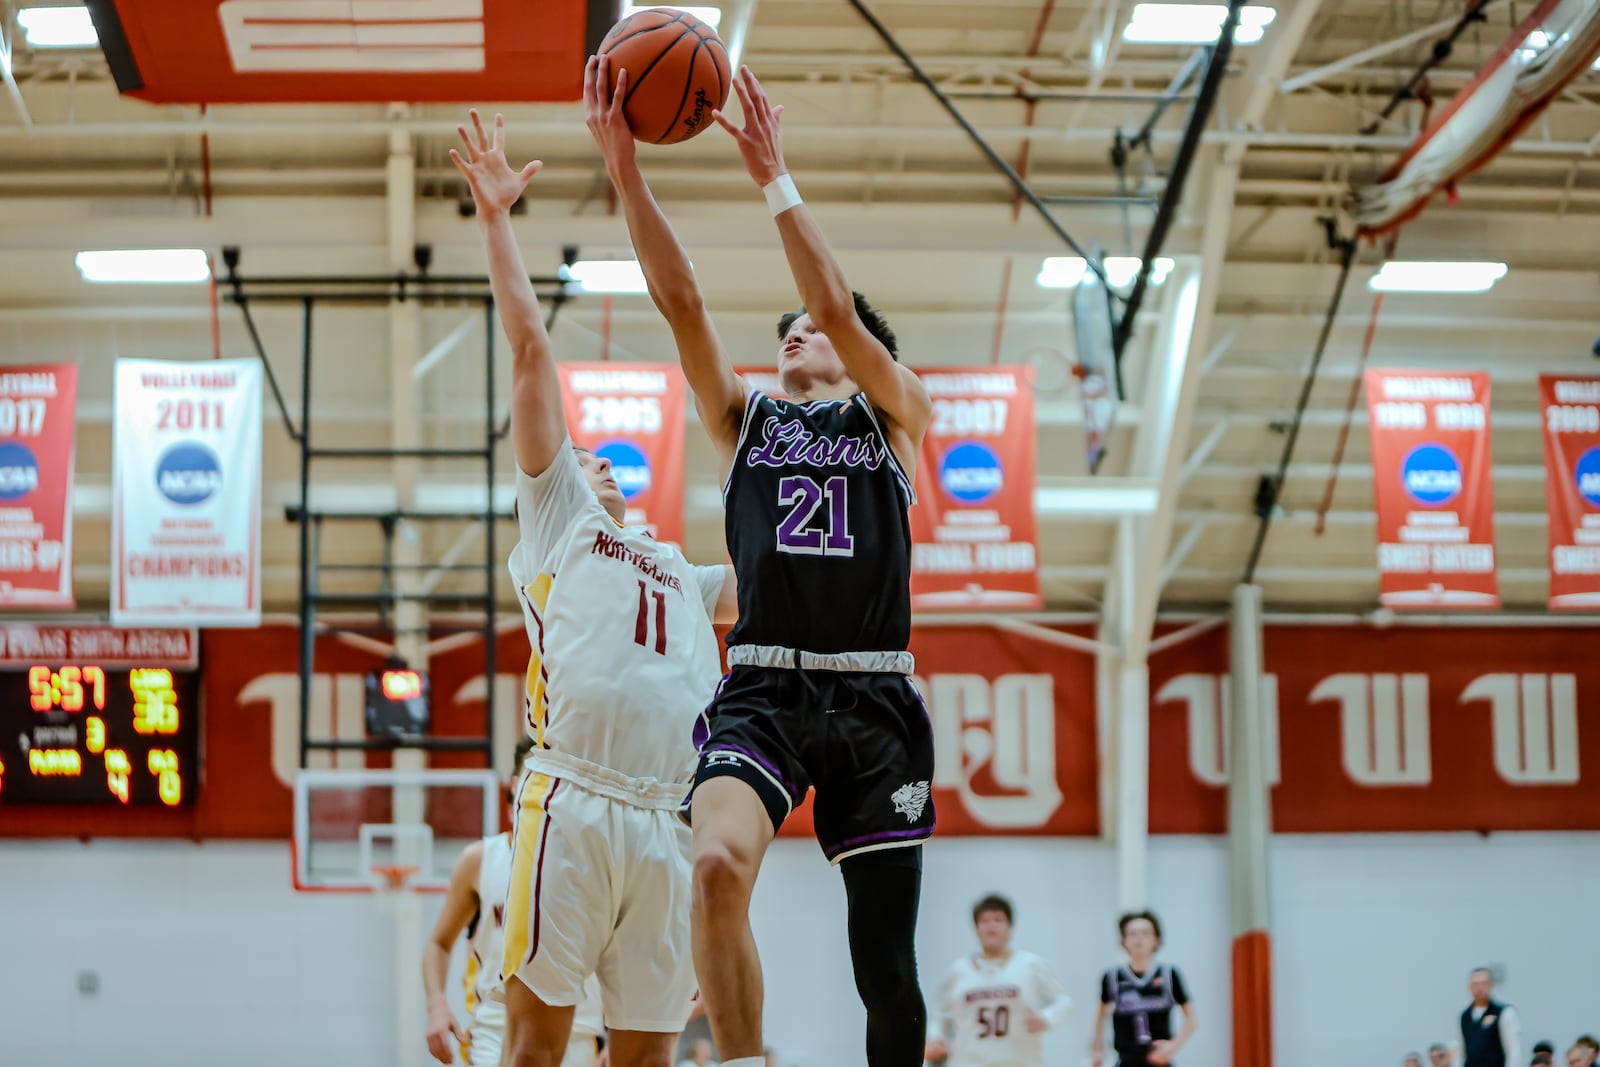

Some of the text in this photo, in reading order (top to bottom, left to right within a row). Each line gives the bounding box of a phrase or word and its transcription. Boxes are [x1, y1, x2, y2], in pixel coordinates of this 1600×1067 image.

[142, 373, 237, 389] VOLLEYBALL
[157, 399, 224, 431] 2011
[580, 397, 663, 432] 2005
[931, 399, 1007, 435] 2007
[747, 416, 886, 471] Lions
[160, 469, 222, 491] NCAA
[942, 467, 1003, 492] NCAA
[1407, 469, 1463, 494] NCAA
[776, 476, 854, 557] 21
[128, 554, 245, 578] CHAMPIONS
[634, 579, 667, 656] 11
[128, 629, 190, 658] ARENA
[29, 666, 105, 712] 5:57
[1308, 673, 1432, 786] W
[1460, 673, 1580, 786] W
[977, 1005, 1010, 1038] 50
